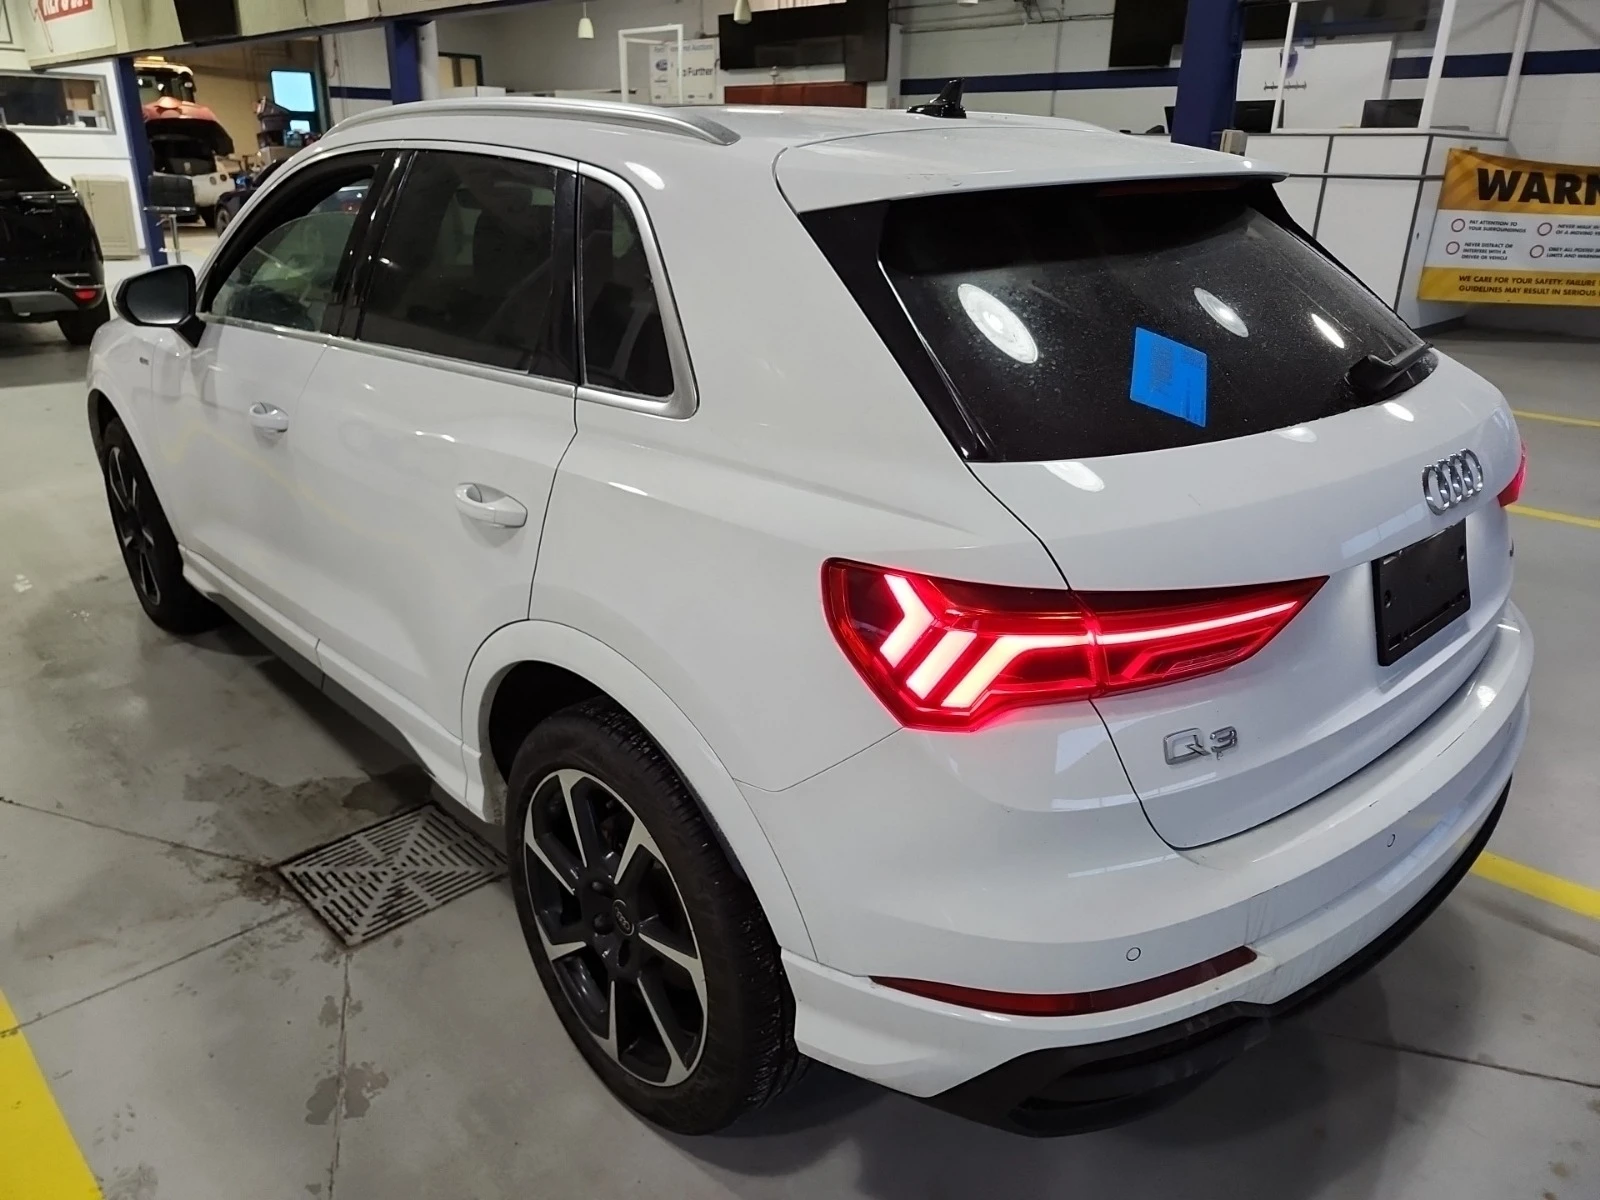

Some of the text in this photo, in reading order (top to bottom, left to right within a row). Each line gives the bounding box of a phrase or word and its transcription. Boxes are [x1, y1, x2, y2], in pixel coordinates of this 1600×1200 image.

[1512, 277, 1533, 285] YOUR
[1535, 278, 1564, 286] SAFETY.
[1458, 285, 1503, 294] GUIDELINES
[1523, 287, 1551, 295] RESULT
[1563, 289, 1597, 297] SERIOUS
[1163, 725, 1237, 766] Q3
